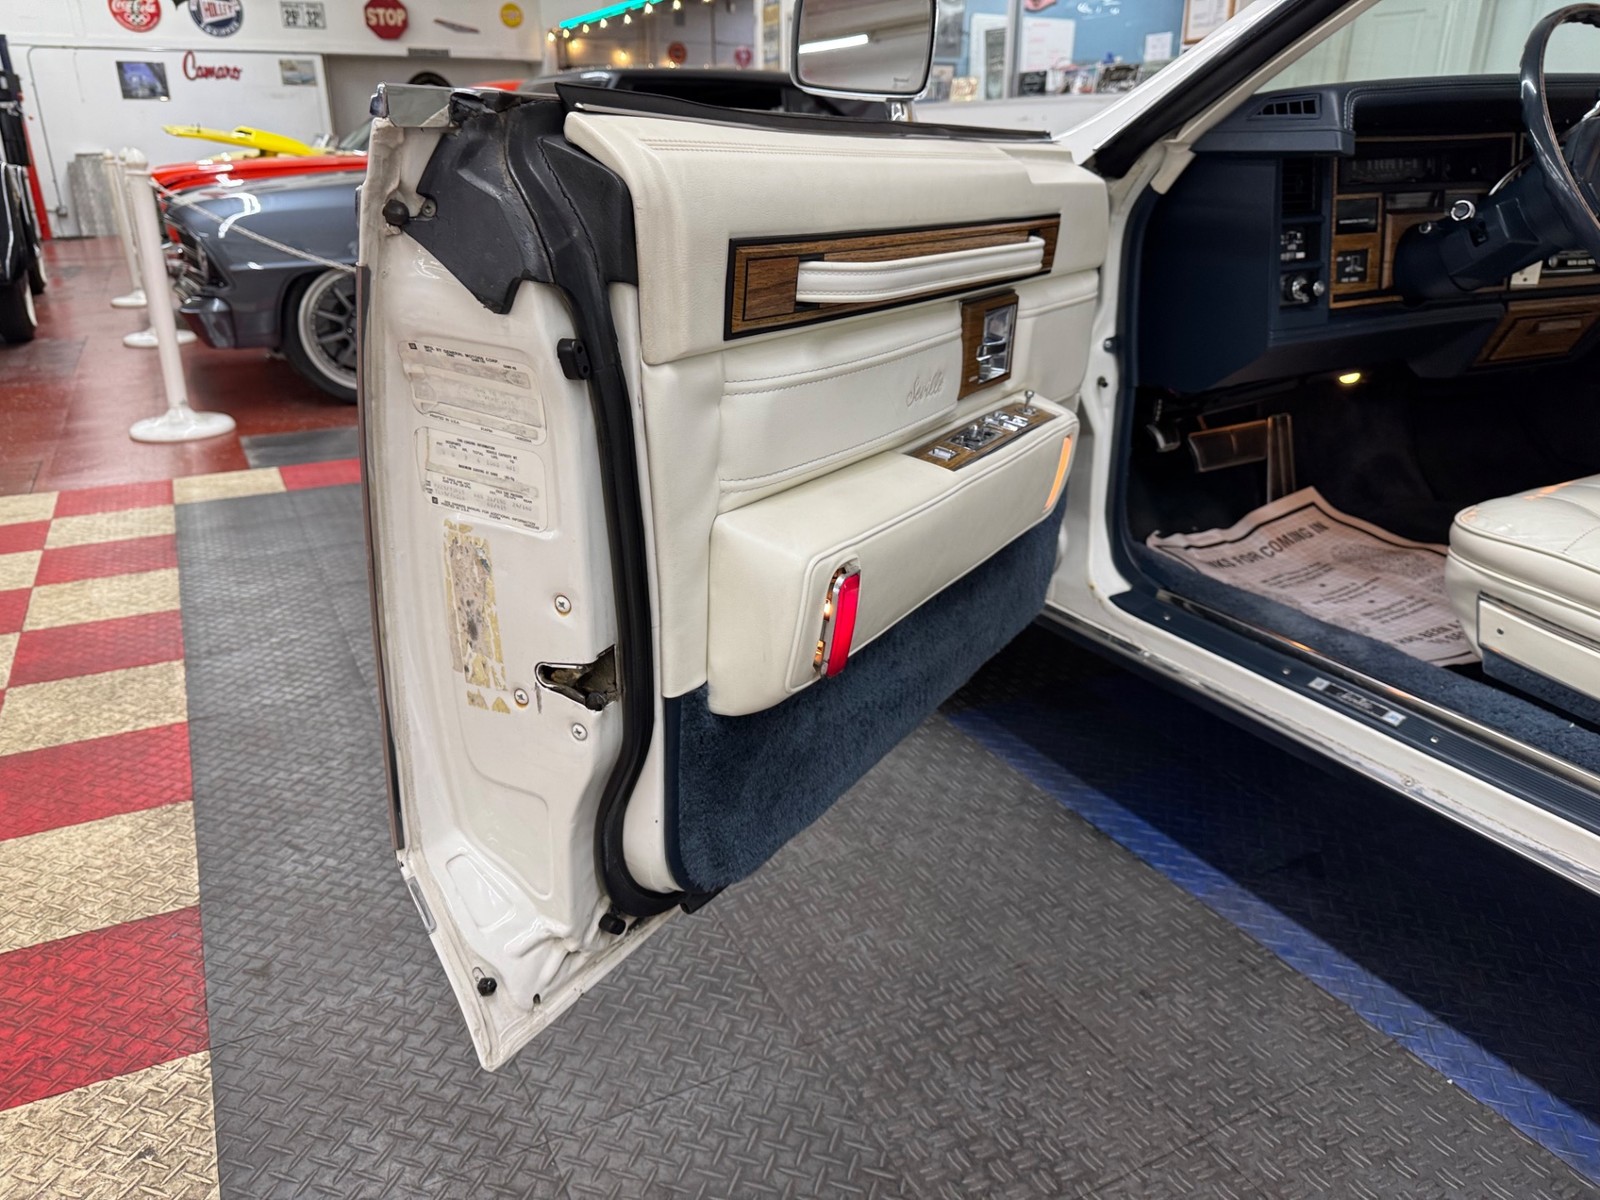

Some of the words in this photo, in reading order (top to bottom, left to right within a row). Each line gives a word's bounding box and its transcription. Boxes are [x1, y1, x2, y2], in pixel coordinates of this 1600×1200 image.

[366, 8, 406, 26] STOP
[183, 49, 241, 81] Camaro
[906, 371, 944, 407] Seville
[1232, 552, 1262, 564] FOR
[1260, 528, 1314, 558] COMING
[1308, 522, 1329, 534] IN
